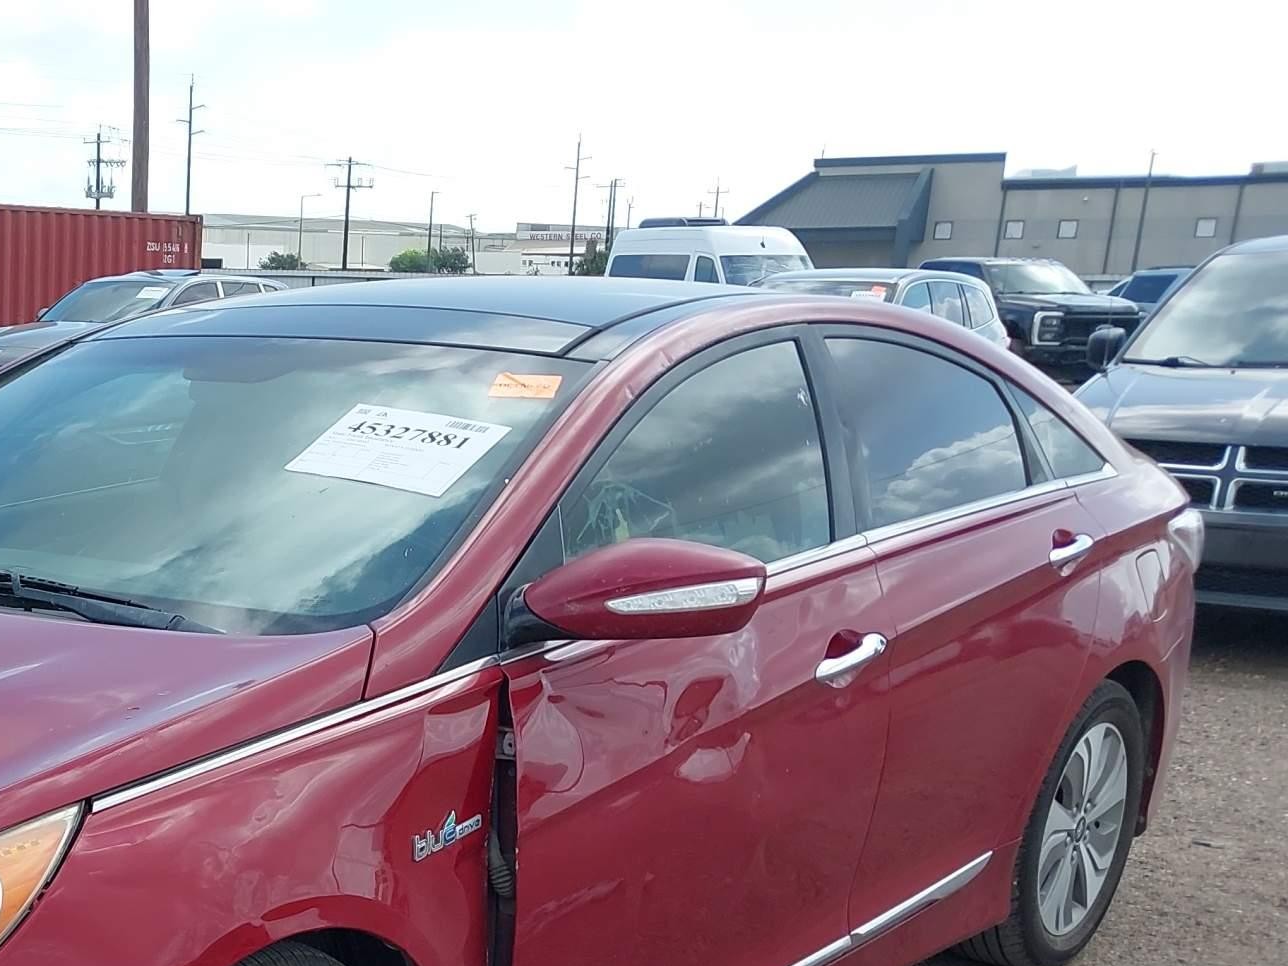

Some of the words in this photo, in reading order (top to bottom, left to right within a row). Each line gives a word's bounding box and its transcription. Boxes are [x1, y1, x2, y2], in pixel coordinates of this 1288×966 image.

[529, 233, 563, 241] WESTERN
[347, 420, 471, 449] 45327881
[414, 822, 457, 862] blue
